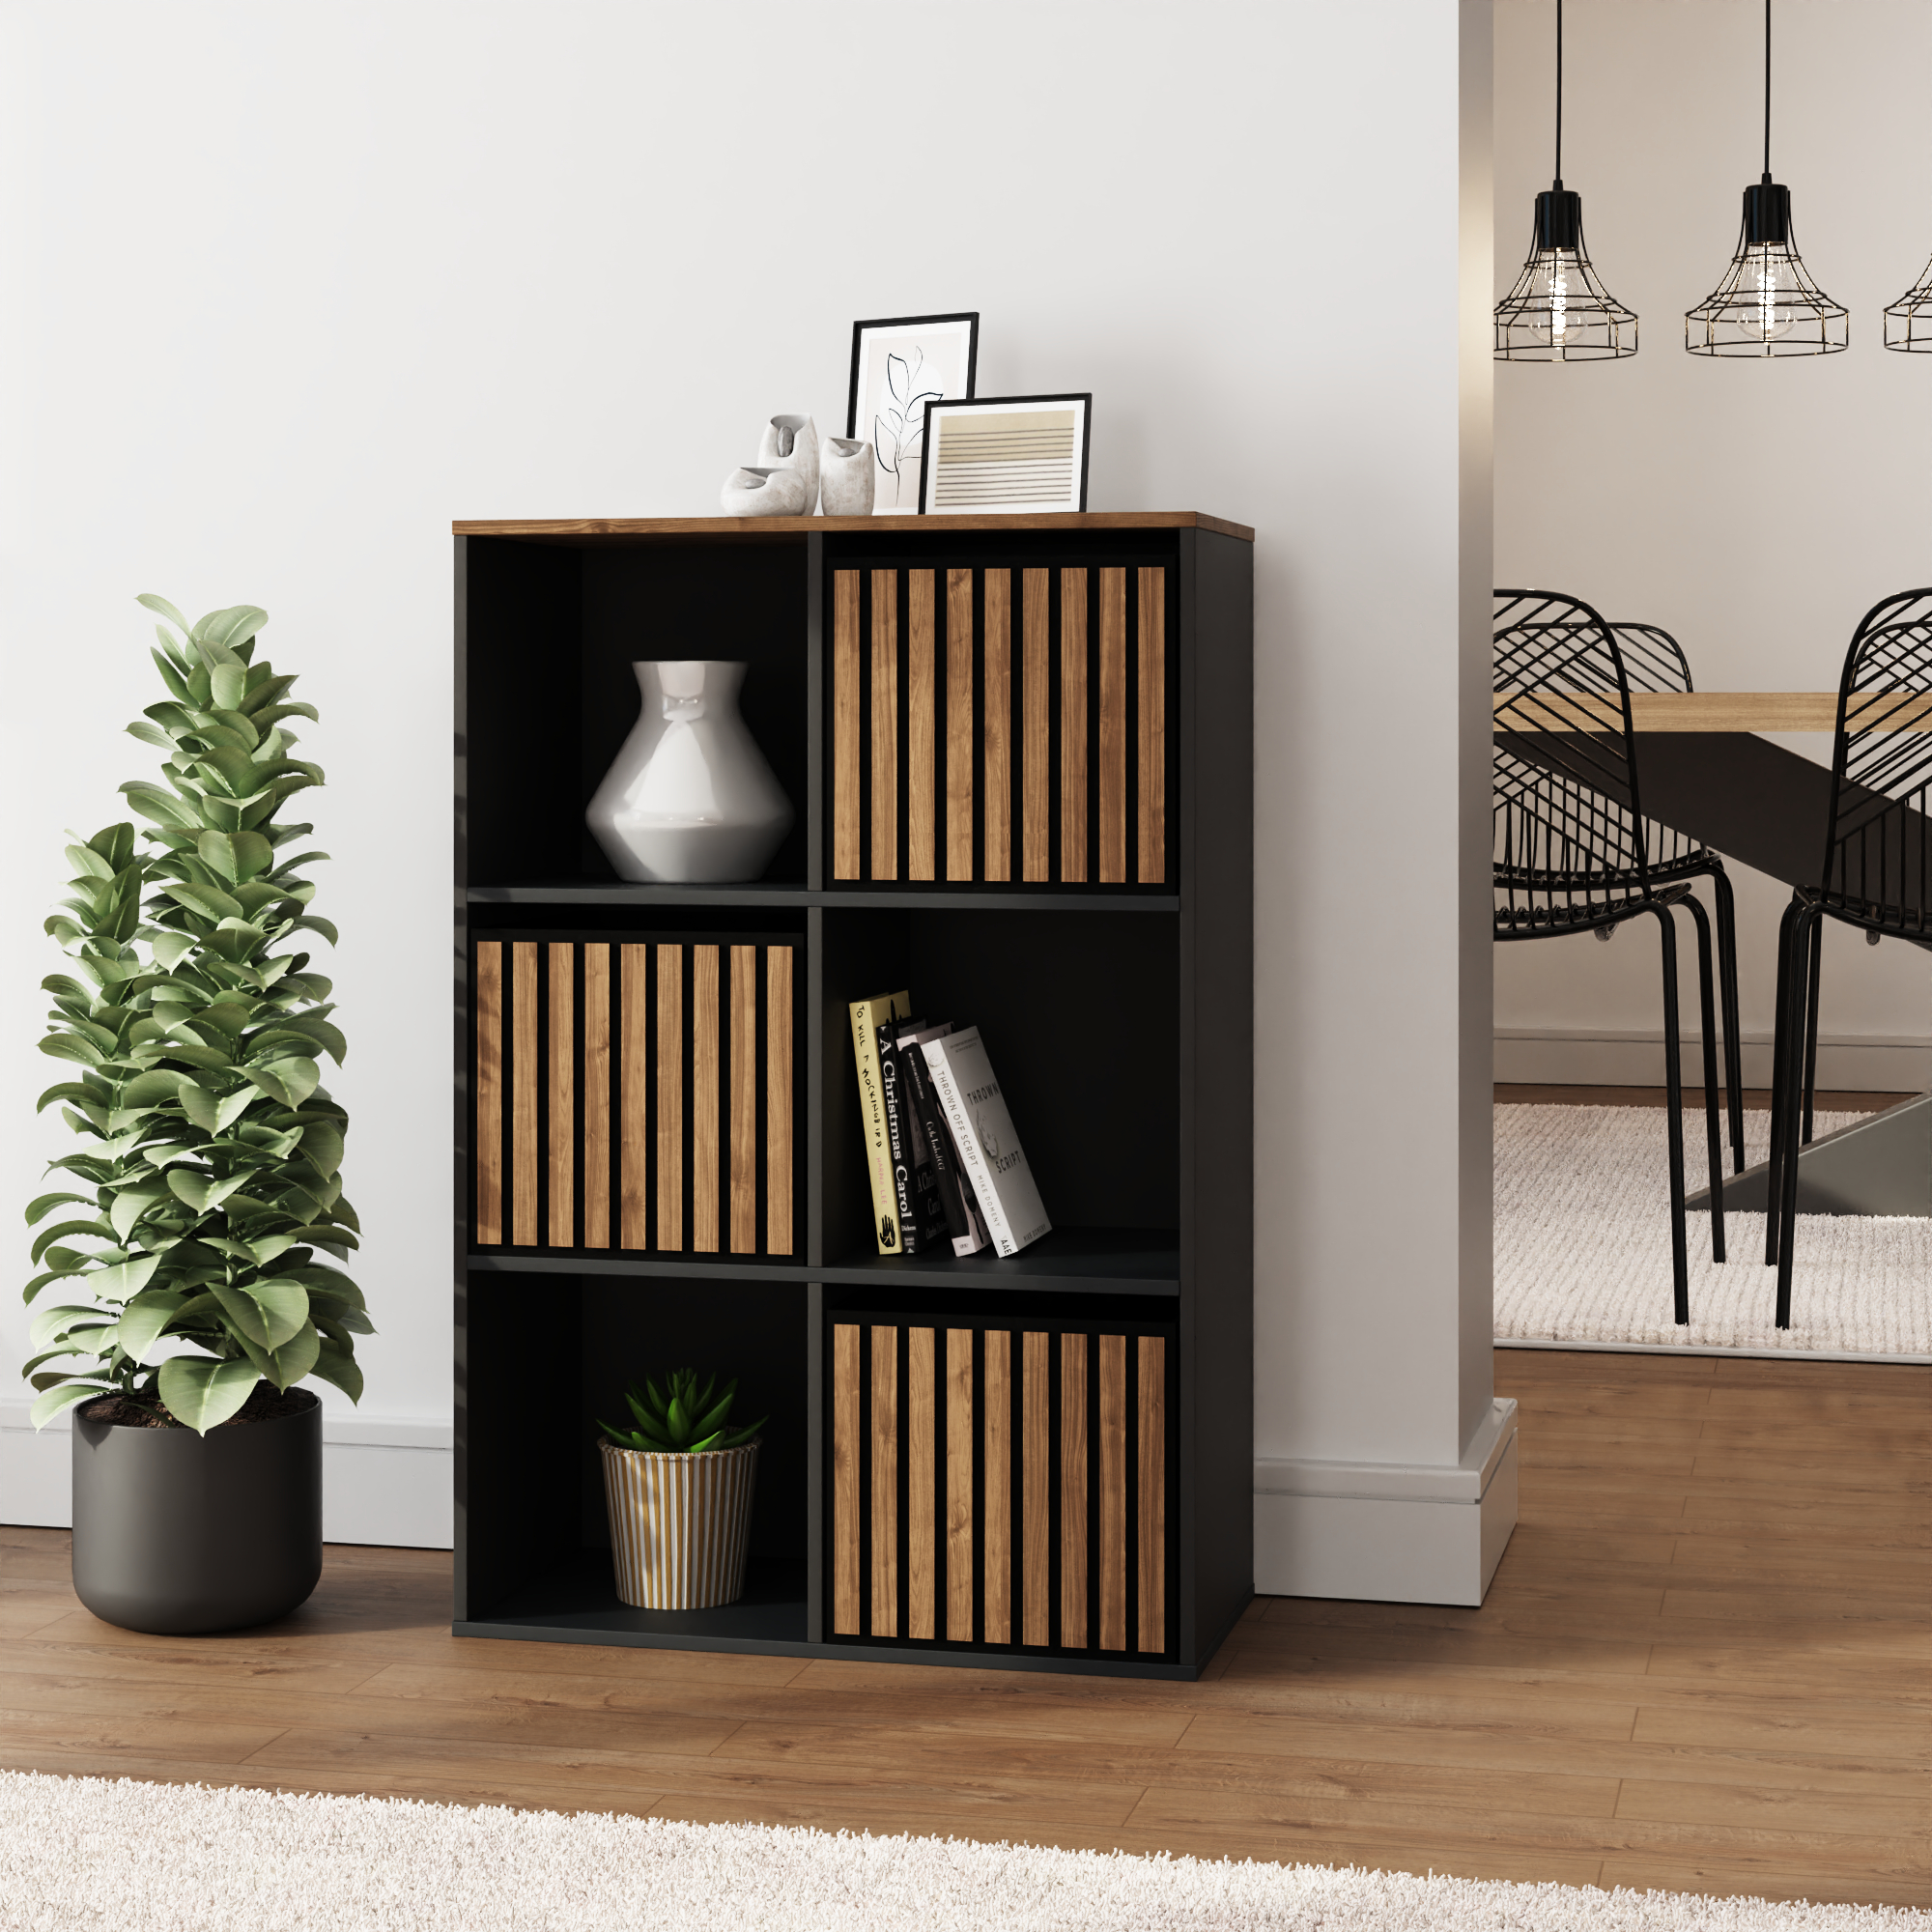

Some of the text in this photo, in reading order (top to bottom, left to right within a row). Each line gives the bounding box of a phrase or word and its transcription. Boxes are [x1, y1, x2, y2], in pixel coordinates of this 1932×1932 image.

[857, 1005, 865, 1018] TO
[864, 1054, 869, 1063] A
[880, 1037, 892, 1055] A
[883, 1061, 901, 1159] Christmas
[937, 1070, 979, 1166] THROWN OFF SCRIPT
[967, 1082, 999, 1105] THROWN
[996, 1151, 1021, 1174] SCRIPT
[895, 1165, 912, 1219] Carol
[977, 1175, 988, 1193] MIKE
[985, 1196, 1001, 1227] DOMENY
[1001, 1239, 1011, 1254] AAE
